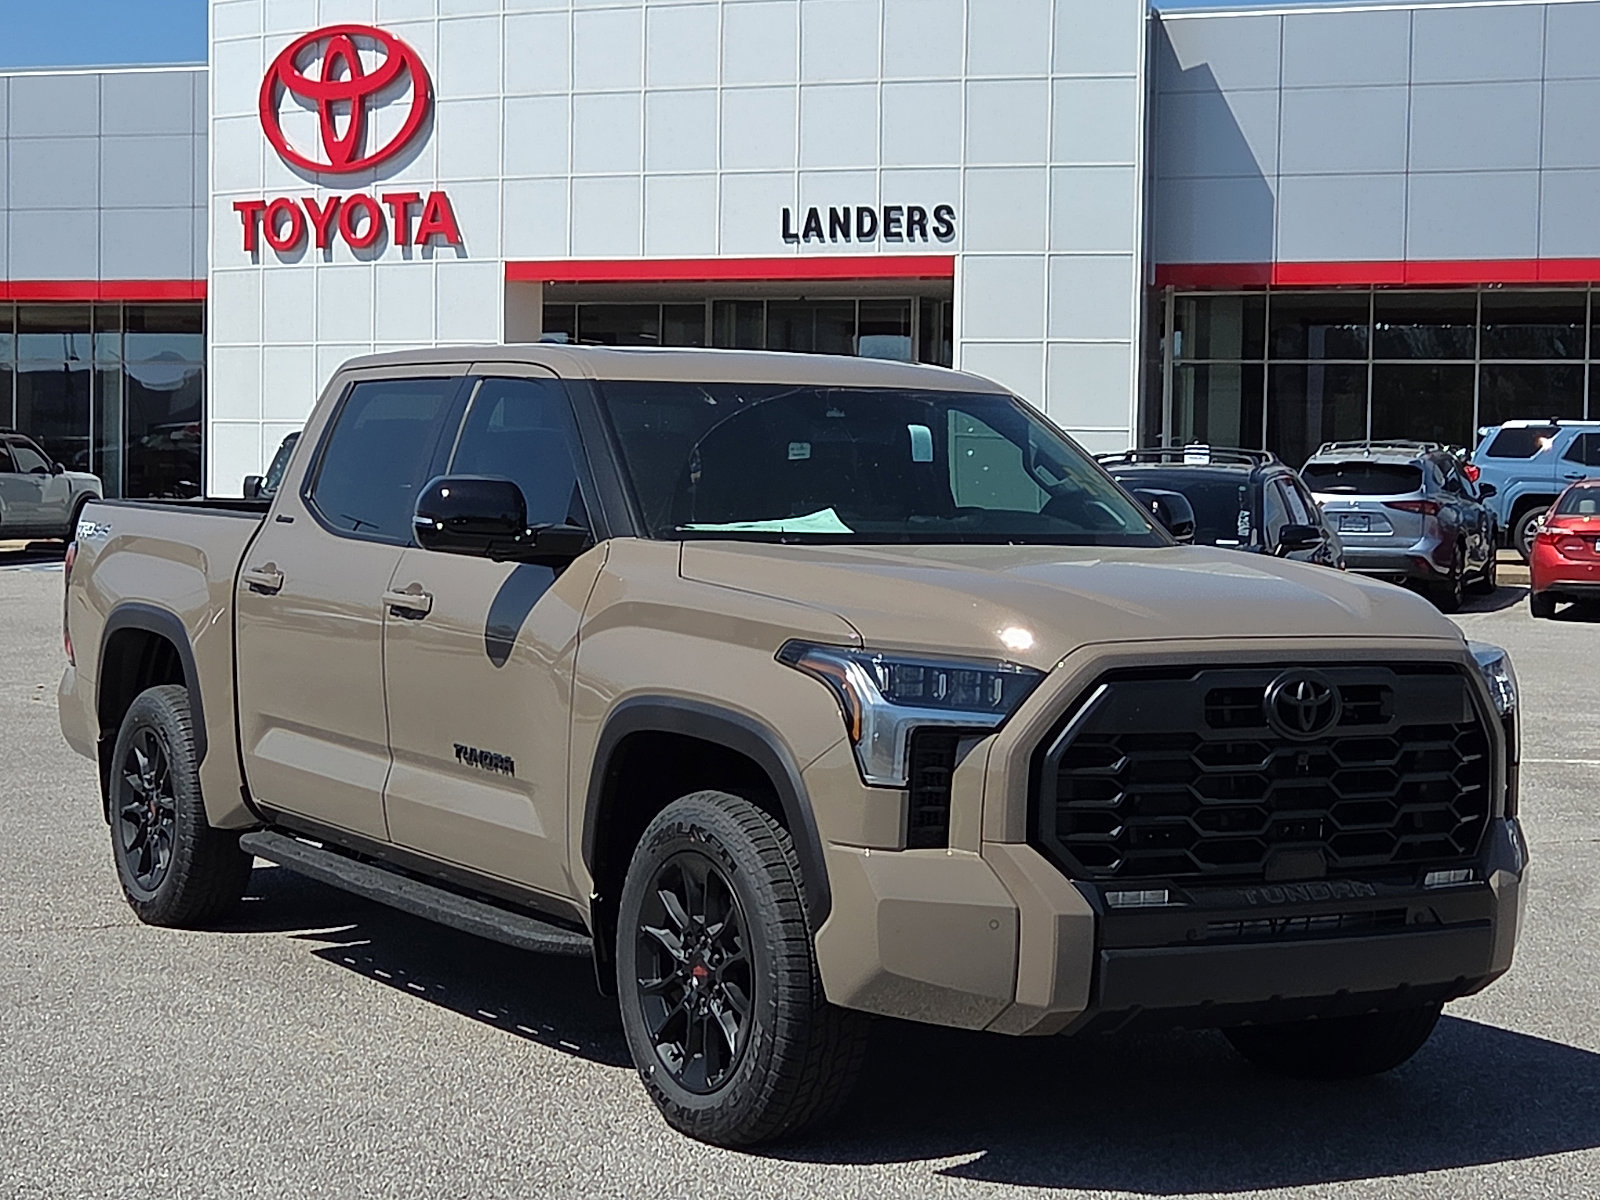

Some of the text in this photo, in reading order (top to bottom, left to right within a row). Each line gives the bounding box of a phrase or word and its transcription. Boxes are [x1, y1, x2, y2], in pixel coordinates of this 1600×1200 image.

[233, 191, 461, 252] TOYOTA
[782, 204, 957, 242] LANDERS
[453, 743, 515, 778] TUNDRA
[1239, 879, 1376, 905] TUNDRA
